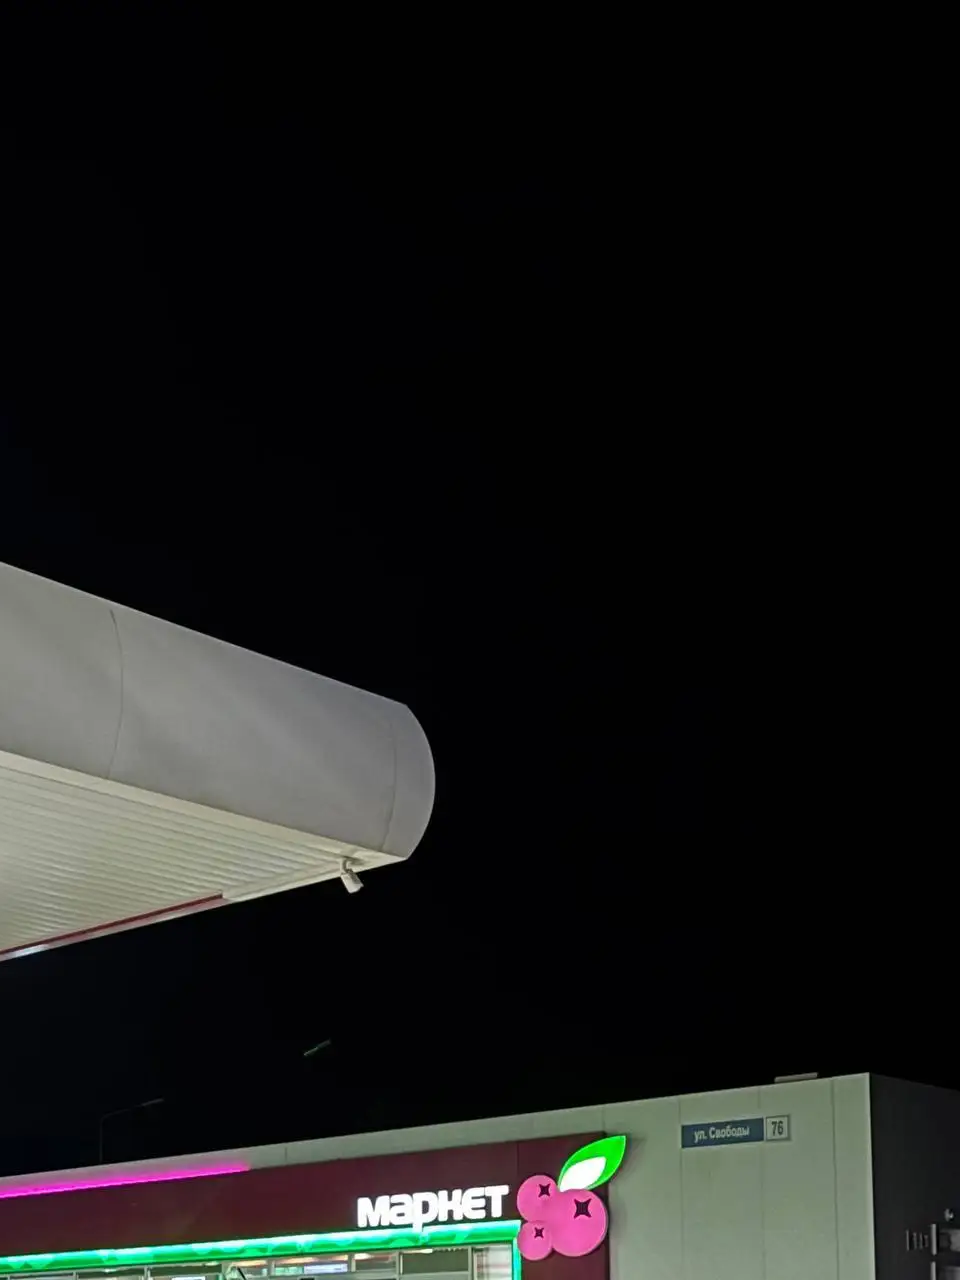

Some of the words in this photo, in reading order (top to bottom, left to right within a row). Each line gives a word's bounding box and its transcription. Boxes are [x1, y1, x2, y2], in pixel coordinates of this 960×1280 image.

[694, 1130, 708, 1143] ул.
[709, 1125, 750, 1139] Свободы
[771, 1121, 784, 1136] 76
